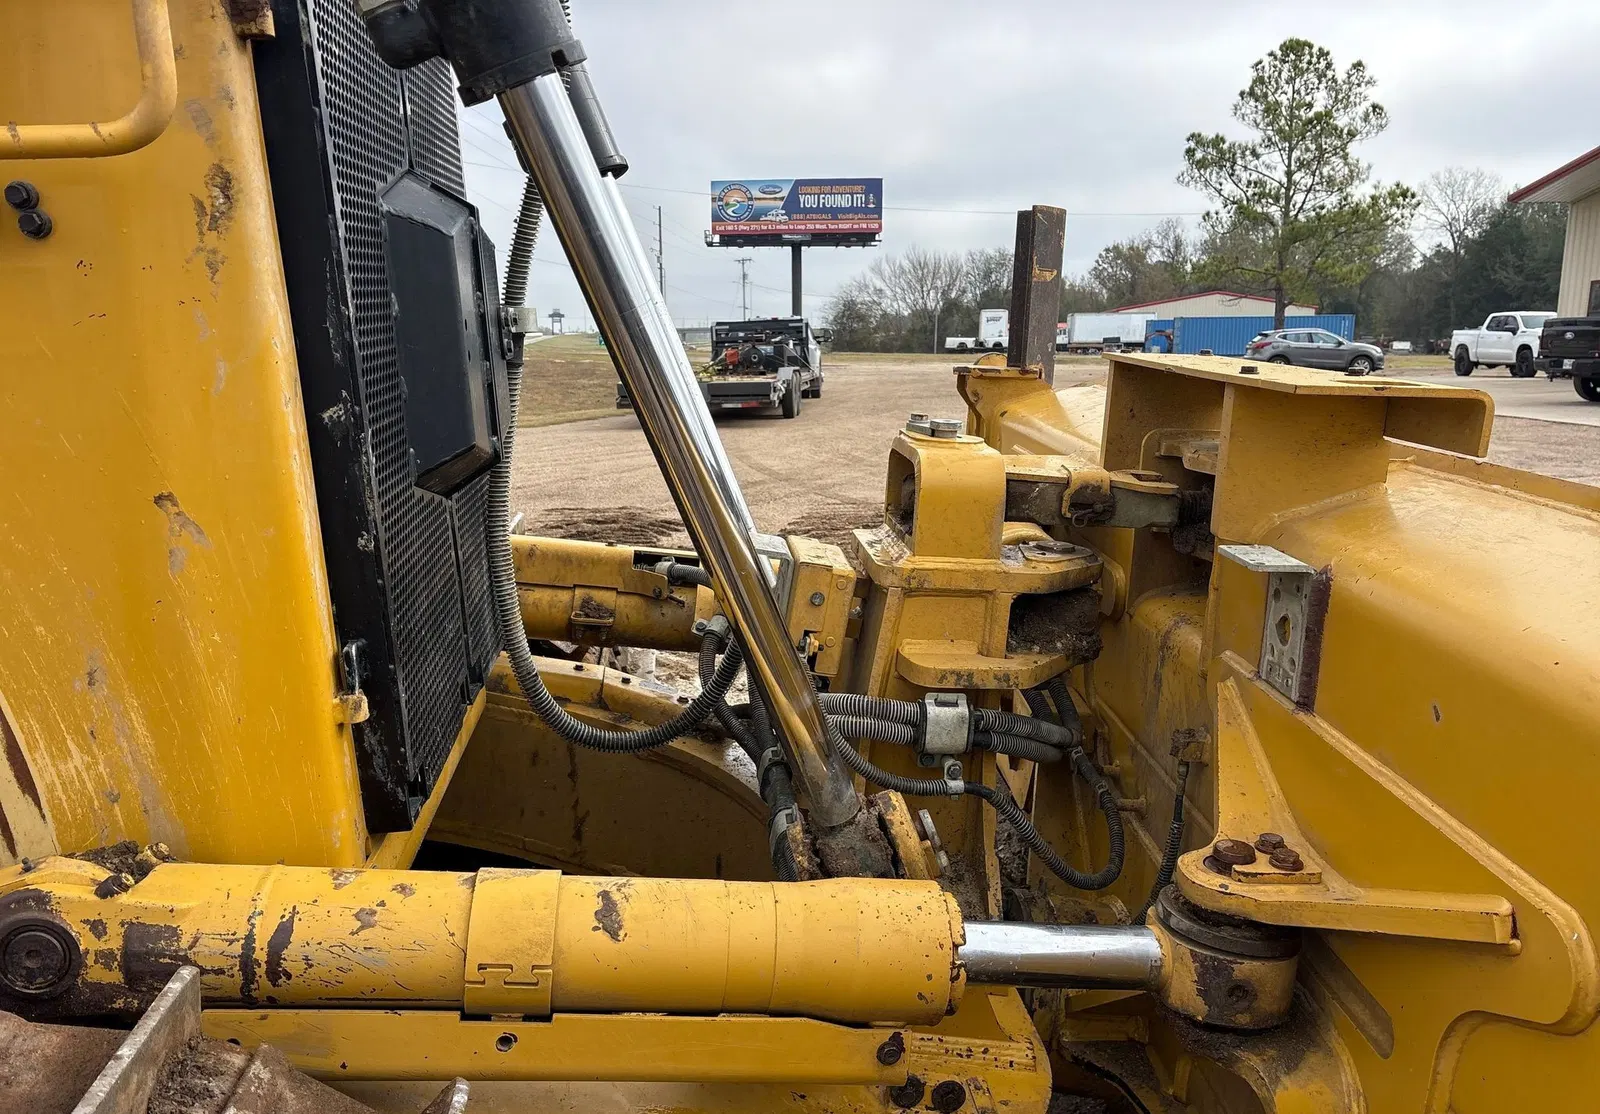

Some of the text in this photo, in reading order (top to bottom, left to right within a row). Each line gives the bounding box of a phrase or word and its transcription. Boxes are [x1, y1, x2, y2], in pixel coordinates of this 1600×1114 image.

[798, 186, 820, 194] LOOKING
[798, 194, 865, 208] YOU FOUND IT!
